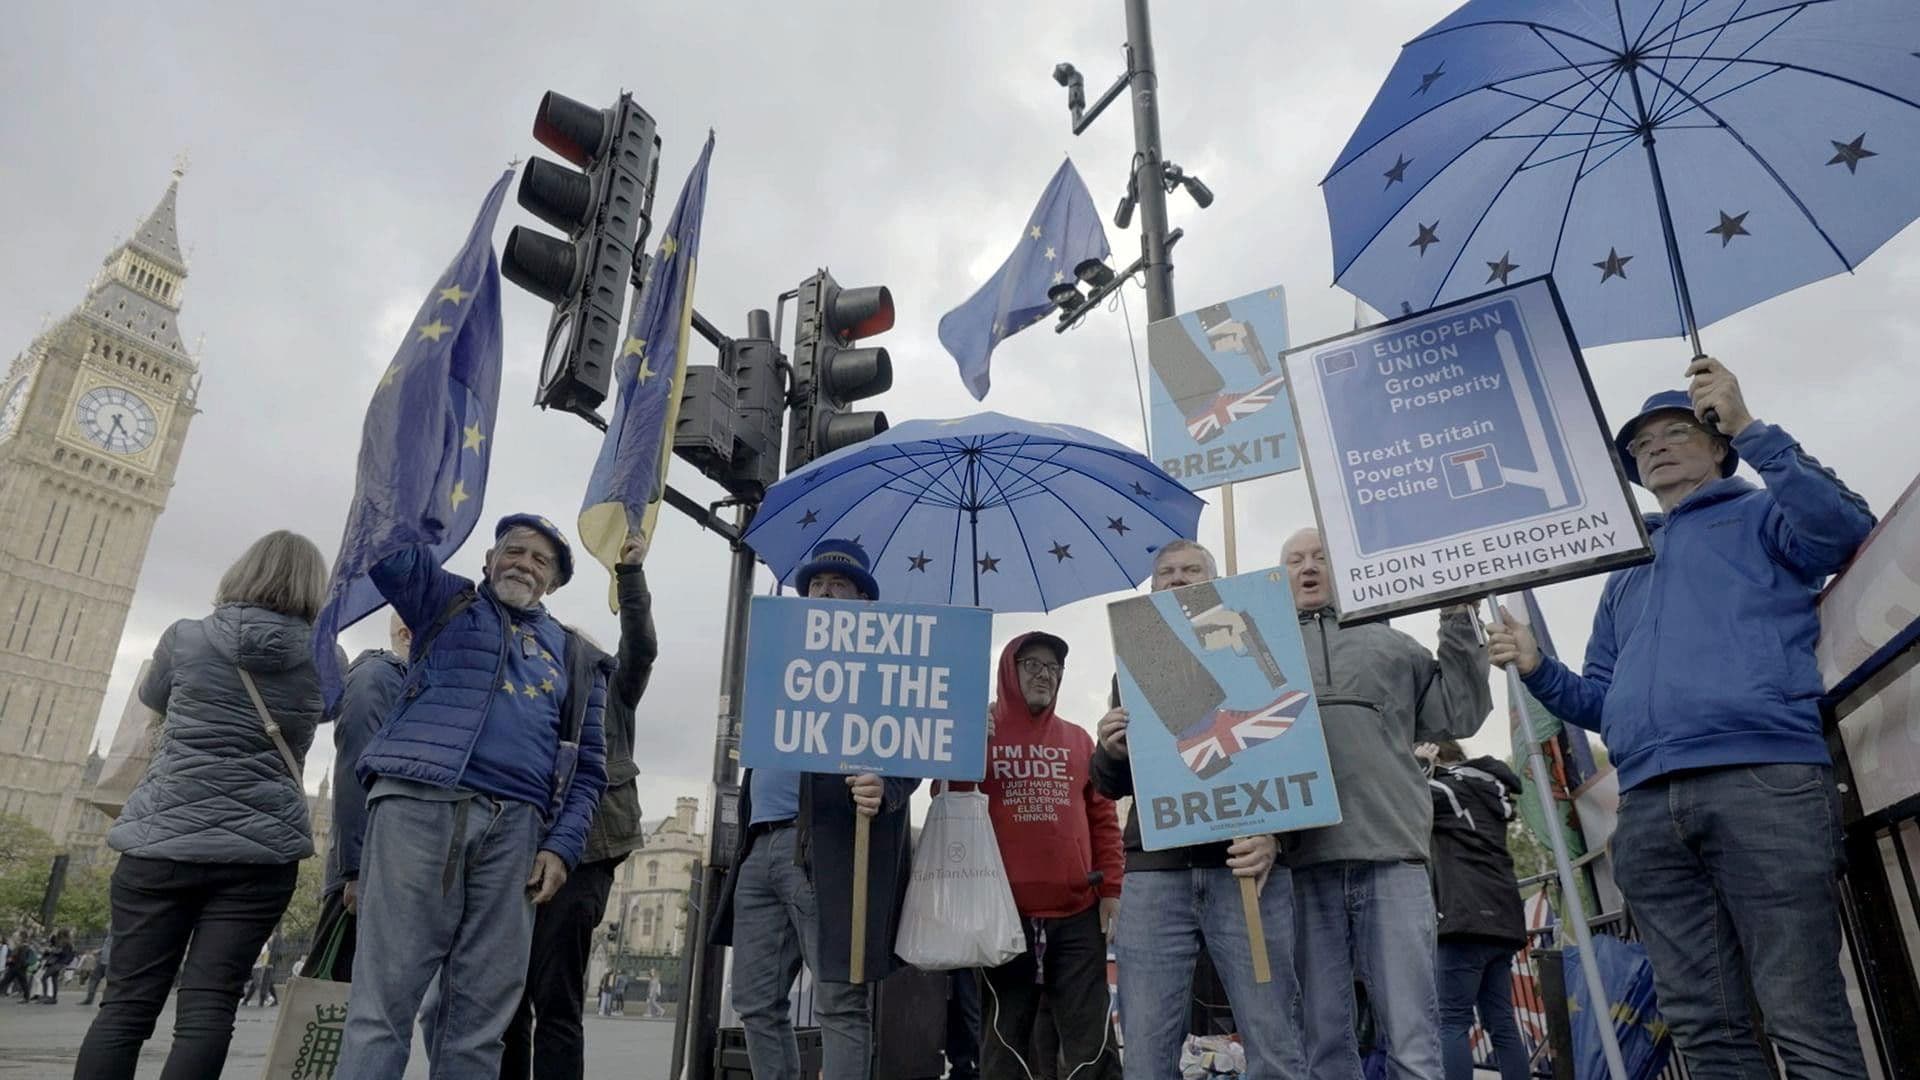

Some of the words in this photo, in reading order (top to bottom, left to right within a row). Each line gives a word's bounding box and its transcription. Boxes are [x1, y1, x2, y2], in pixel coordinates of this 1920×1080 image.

[1373, 309, 1501, 358] EUROPEAN
[1378, 343, 1459, 376] UNION
[1385, 363, 1464, 394] Growth
[1390, 373, 1501, 413] Prosperity
[1161, 432, 1287, 480] BREXIT
[1346, 438, 1412, 466] Brexit
[1418, 419, 1495, 449] Britain
[1353, 456, 1435, 486] Poverty
[1357, 476, 1439, 505] Decline
[1350, 553, 1426, 583] REJOIN
[1433, 541, 1475, 565] THE
[1482, 511, 1609, 552] EUROPEAN
[1352, 574, 1425, 602] UNION
[1431, 531, 1617, 585] SUPERHIGHWAY
[805, 608, 937, 657] BREXIT
[784, 659, 866, 704] GOT
[878, 664, 950, 709] THE
[774, 709, 831, 754] UK
[841, 713, 954, 762] DONE
[992, 745, 1022, 760] I'M
[1029, 744, 1071, 760] NOT
[993, 760, 1074, 780] RUDE.
[1007, 780, 1027, 789] JUST
[1030, 780, 1052, 789] HAVE
[1054, 781, 1070, 790] THE
[1002, 797, 1027, 806] WHAT
[1029, 796, 1071, 807] EVERYONE
[1006, 788, 1035, 797] BALLS
[1037, 788, 1049, 796] TO
[1052, 789, 1069, 798] SAY
[1017, 804, 1043, 813] ELSE
[1045, 804, 1054, 813] IS
[1151, 771, 1319, 831] BREXIT
[1013, 813, 1058, 822] THINKING
